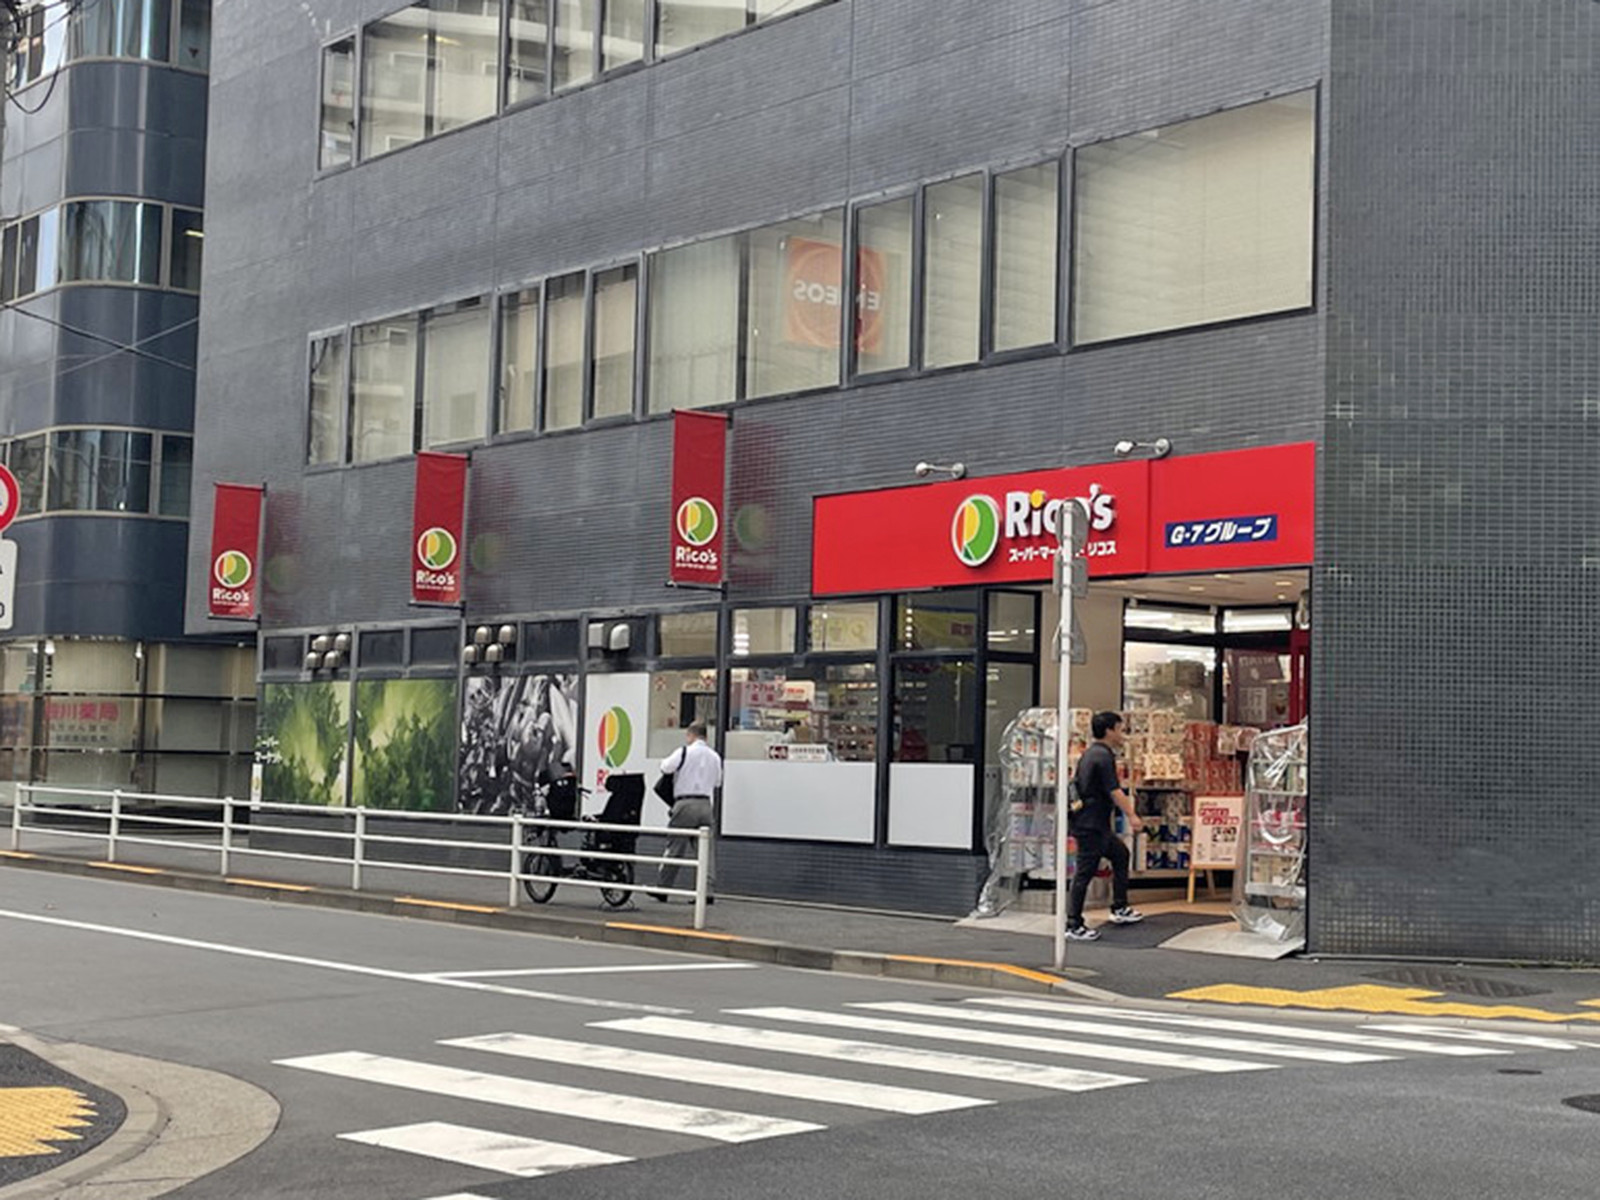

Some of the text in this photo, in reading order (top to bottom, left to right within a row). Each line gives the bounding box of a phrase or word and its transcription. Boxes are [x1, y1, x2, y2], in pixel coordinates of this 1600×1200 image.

[676, 546, 718, 564] Rico's
[1008, 540, 1117, 562] スーパーマー リコス
[416, 569, 455, 585] Rico's
[213, 588, 250, 602] Rico's
